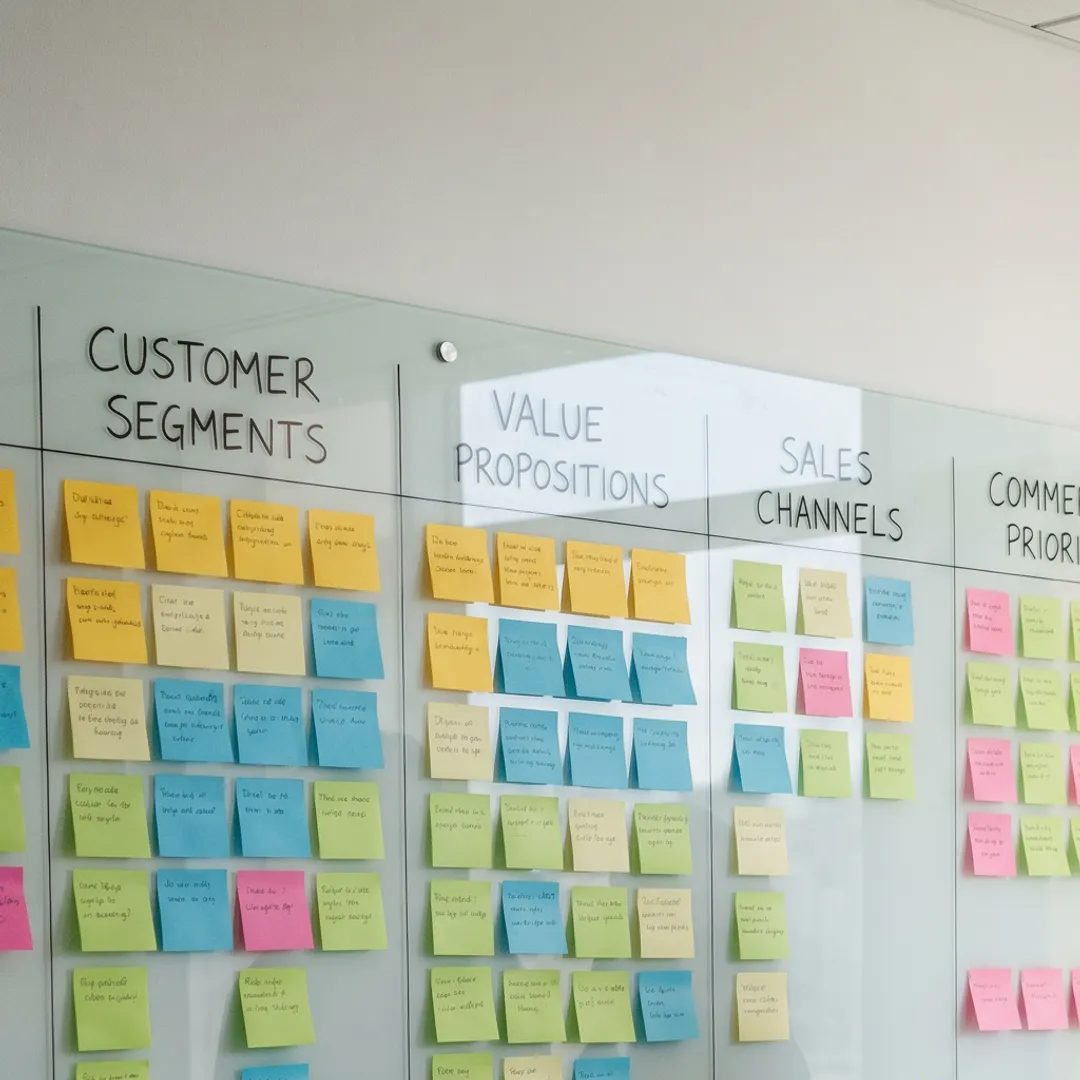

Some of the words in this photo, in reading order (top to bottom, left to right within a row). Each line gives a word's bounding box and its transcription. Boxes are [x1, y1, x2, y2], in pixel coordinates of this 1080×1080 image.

[89, 326, 320, 402] CUSTOMER
[107, 395, 327, 464] SEGMENTS
[493, 389, 603, 442] VALUE
[456, 443, 669, 508] PROPOSITIONS
[780, 436, 872, 486] SALES
[757, 490, 903, 542] CHANNELS
